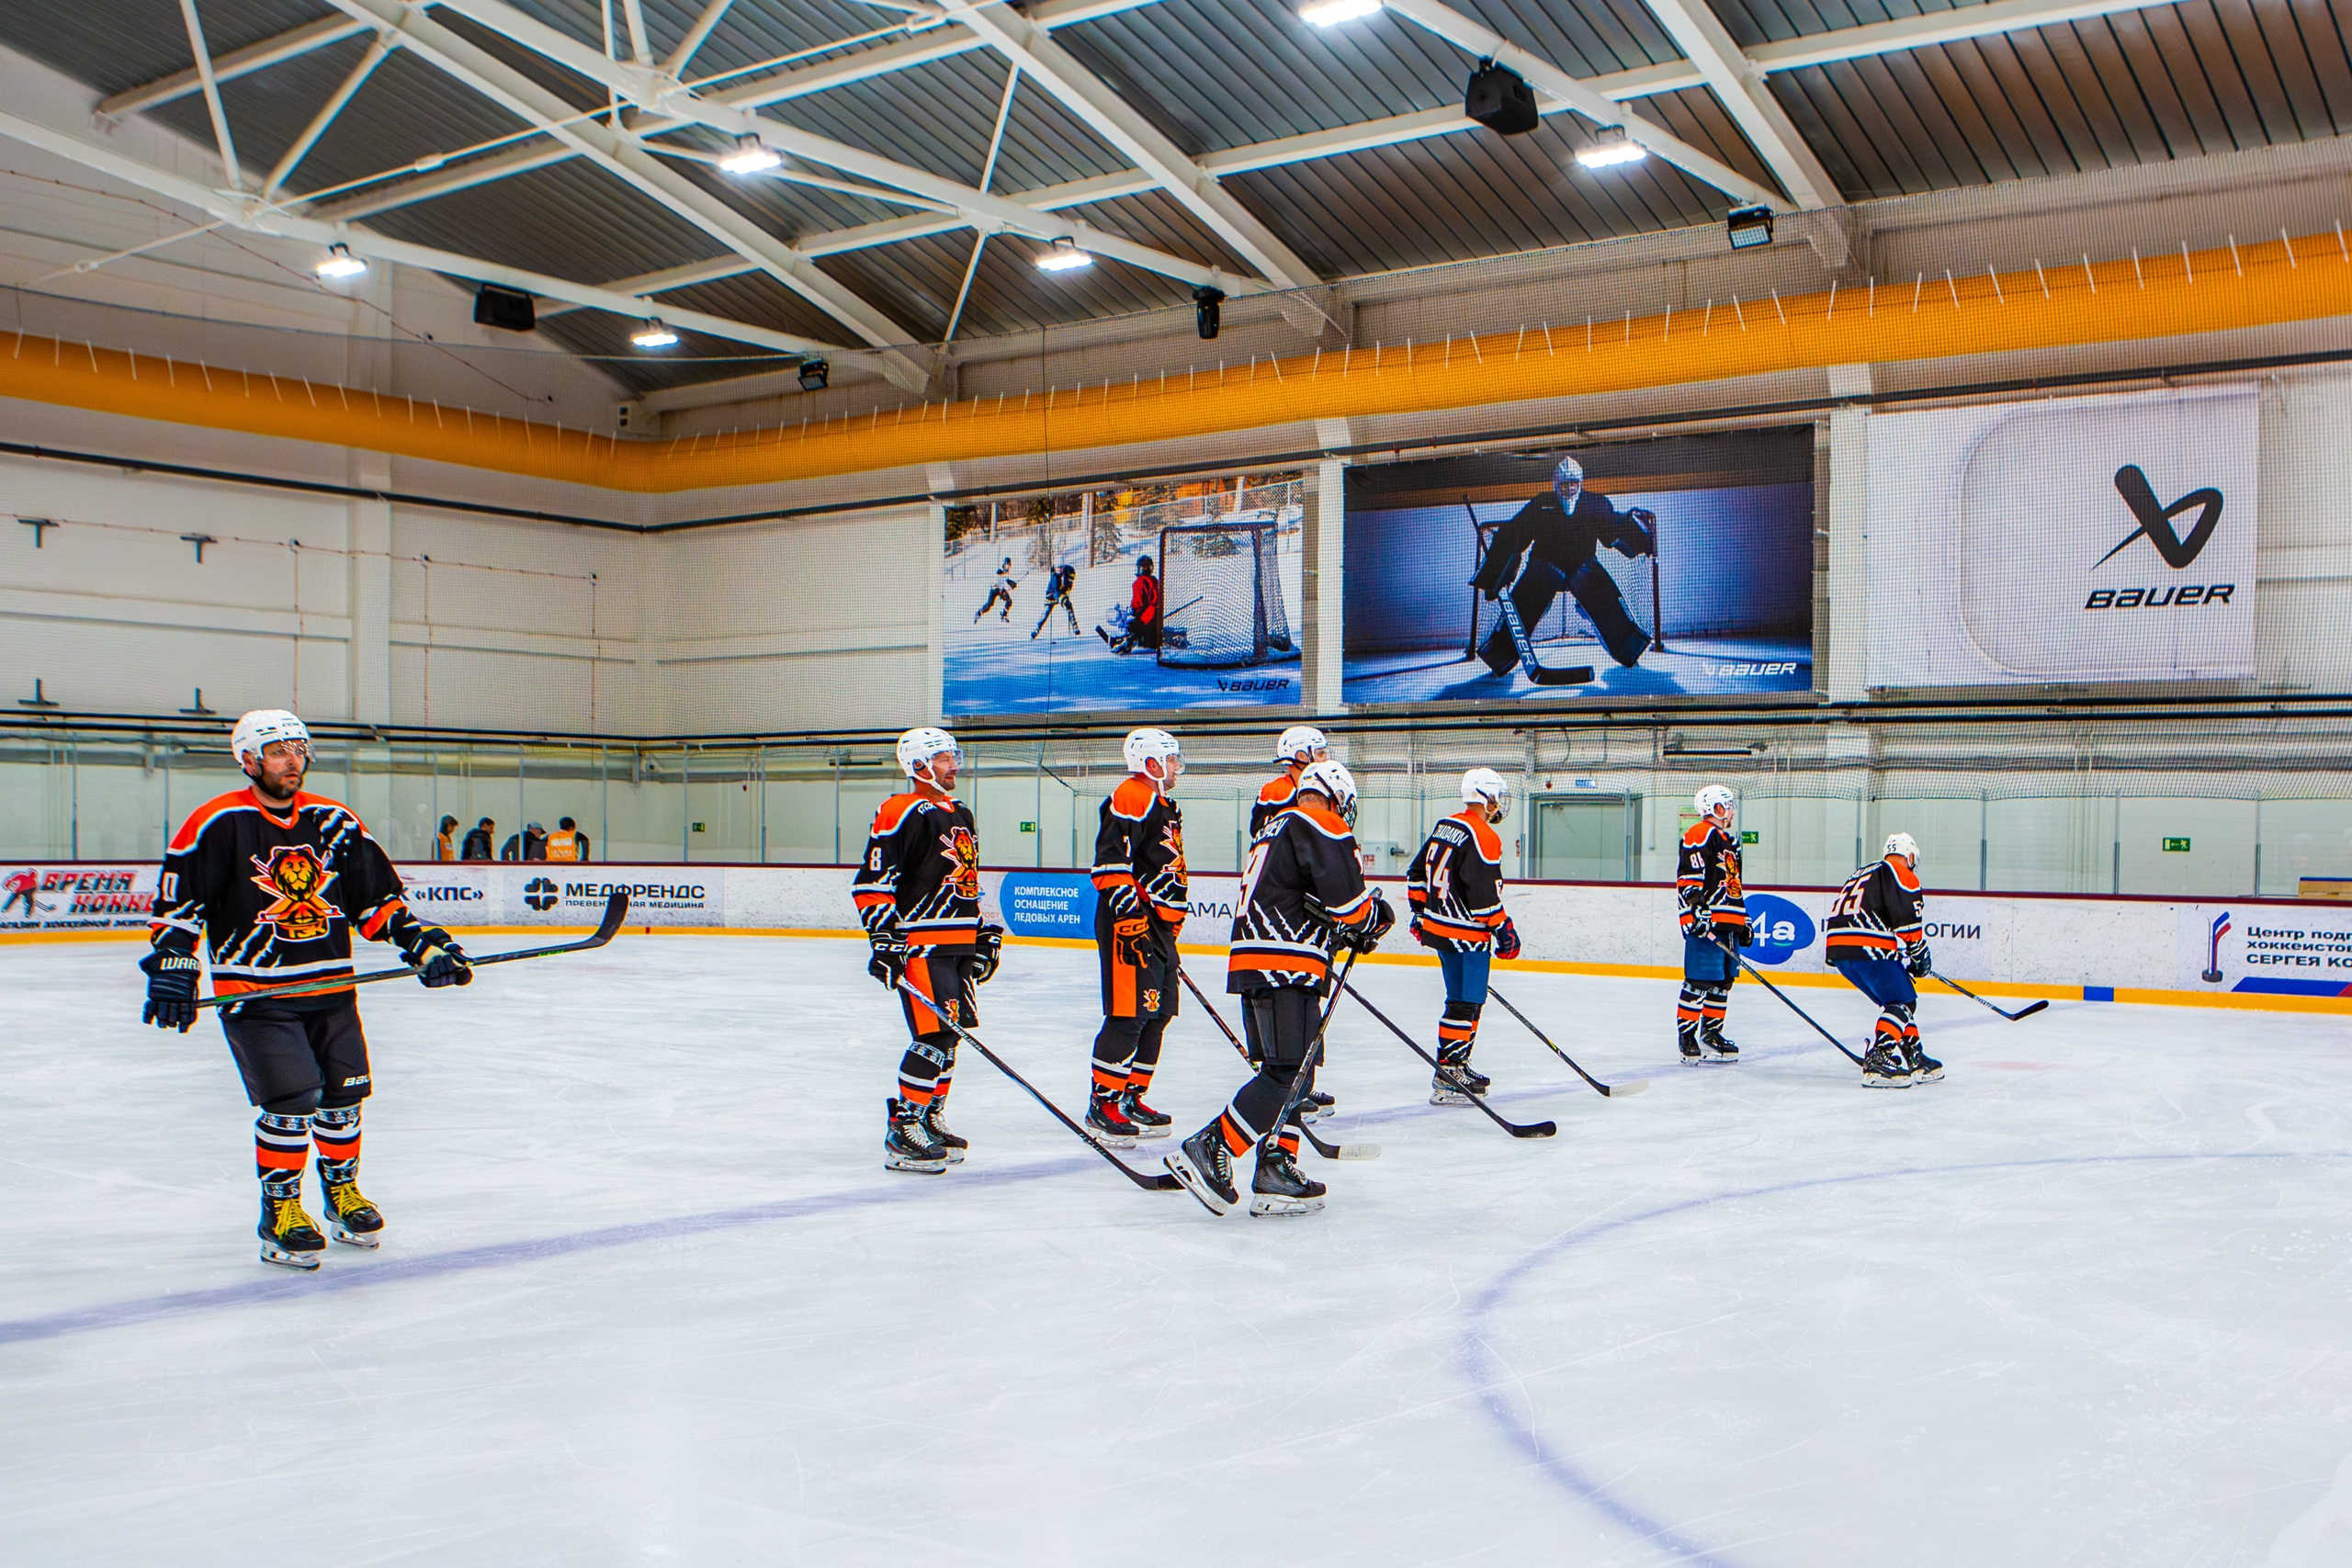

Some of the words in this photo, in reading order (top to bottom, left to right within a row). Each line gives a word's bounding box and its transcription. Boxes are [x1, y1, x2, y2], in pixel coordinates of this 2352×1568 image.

[2085, 583, 2235, 609] BAUER
[1503, 601, 1535, 666] BAUER
[1719, 662, 1797, 676] BAUER
[1230, 679, 1290, 692] BAUER
[869, 847, 882, 871] 8
[414, 886, 484, 901] «КПС»
[565, 883, 706, 898] МЕДФРЕНДС
[1014, 886, 1079, 897] КОМПЛЕКСНОЕ
[1828, 874, 1872, 919] 55
[1014, 899, 1069, 911] ОСНАЩЕНИЕ
[1014, 912, 1056, 923] ЛЕДОВЫХ
[1057, 914, 1080, 924] АРЕН
[1924, 922, 1981, 939] ОГИИ
[2247, 927, 2304, 941] Центр
[2246, 953, 2320, 966] СЕРГЕЯ
